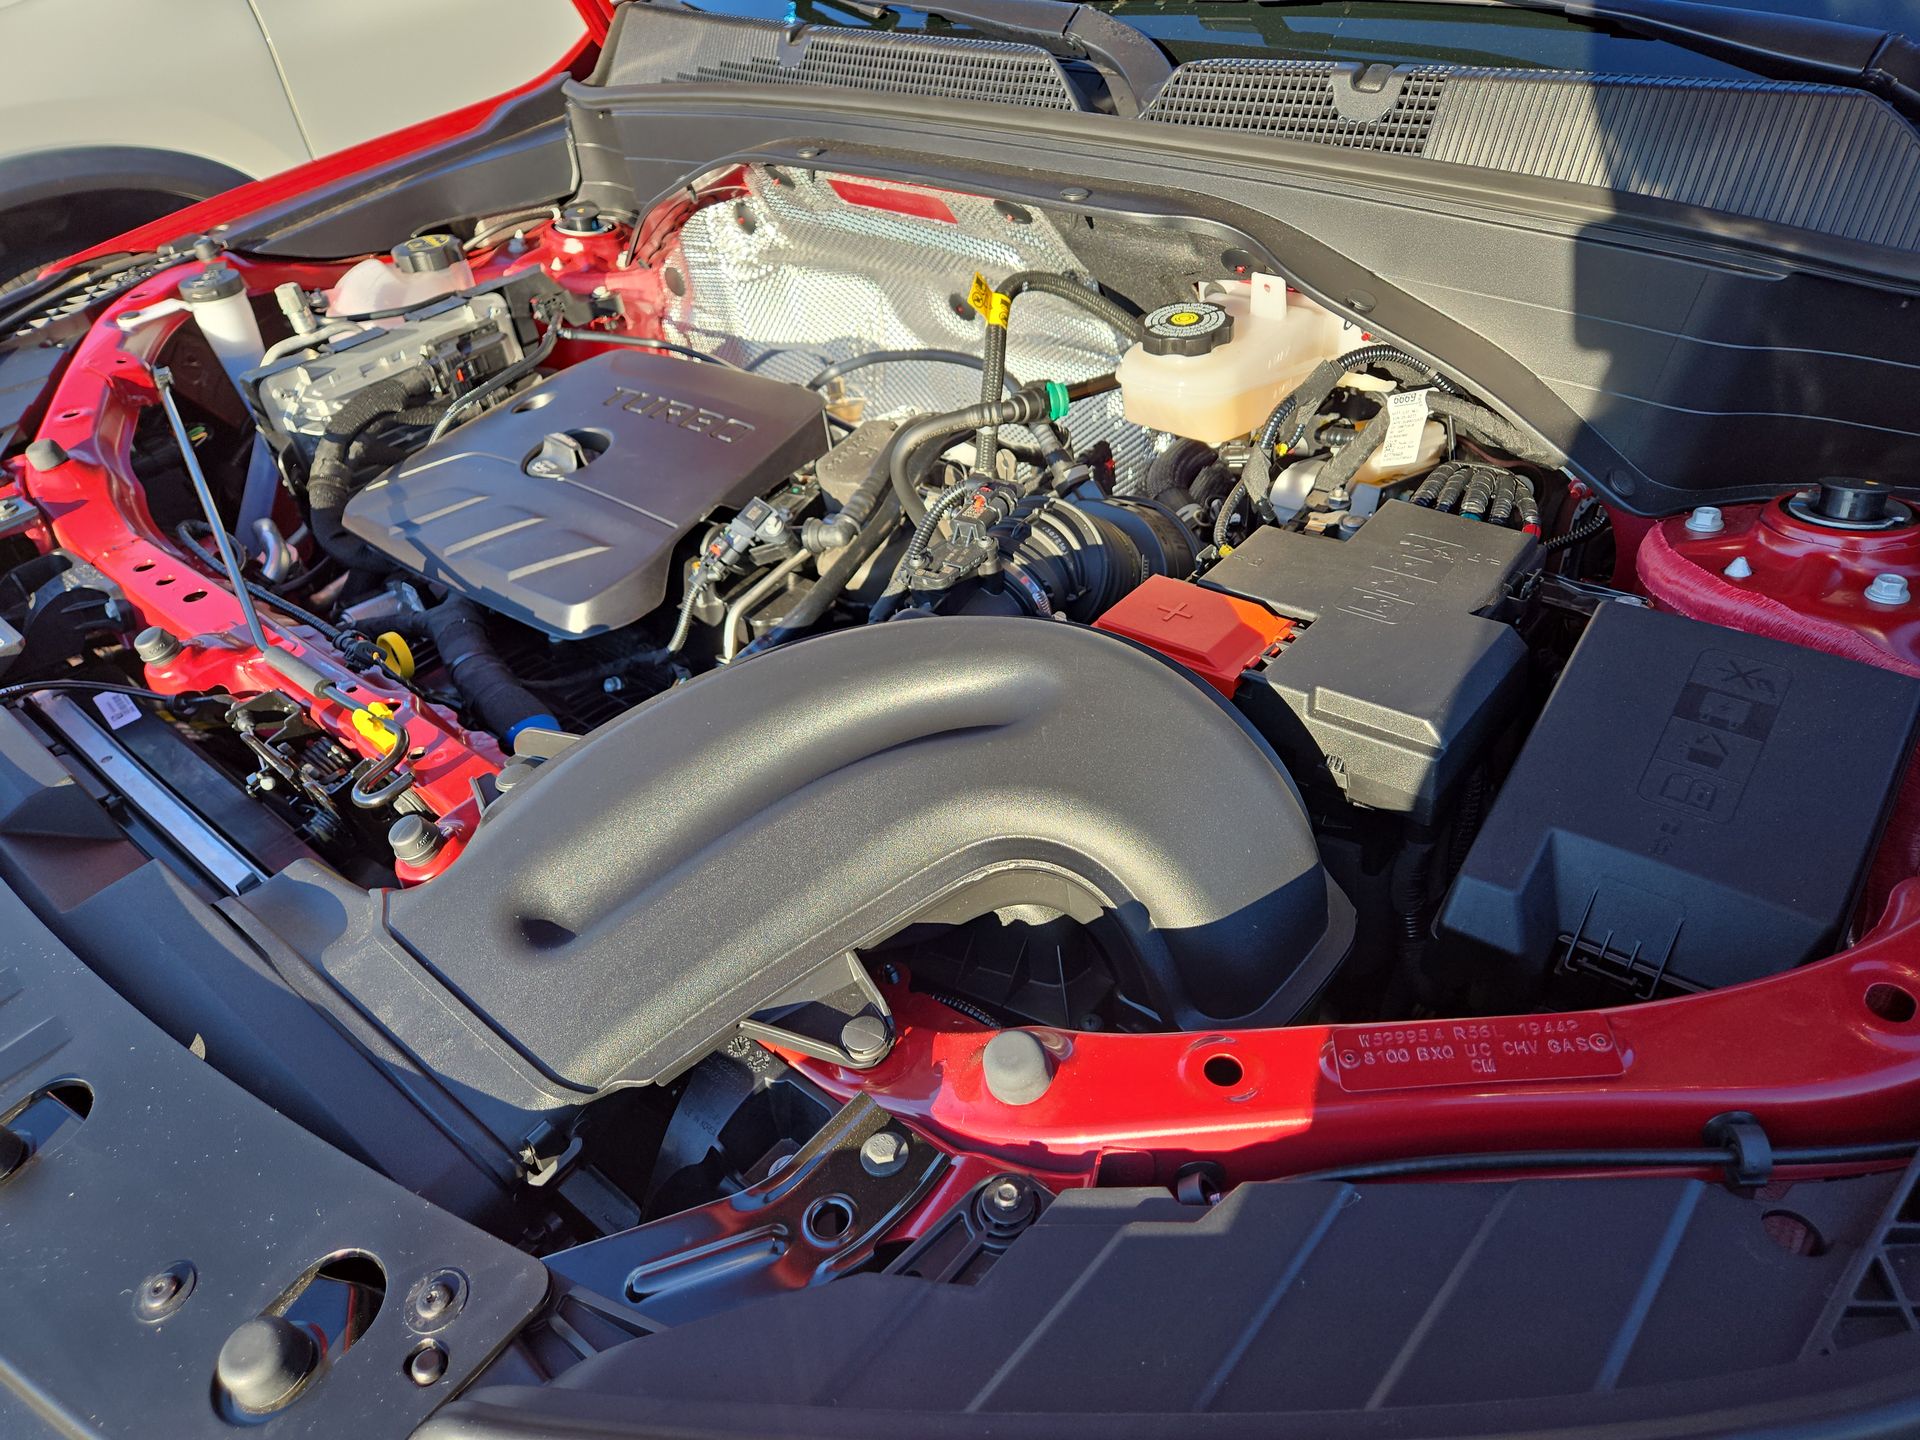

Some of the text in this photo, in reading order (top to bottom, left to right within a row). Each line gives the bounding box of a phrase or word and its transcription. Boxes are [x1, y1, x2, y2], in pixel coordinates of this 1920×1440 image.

[602, 386, 756, 443] TURBO
[1364, 1047, 1411, 1065] 8100
[1464, 1041, 1492, 1058] UC
[1502, 1039, 1538, 1056] CHV
[1547, 1036, 1590, 1054] GAS
[1471, 1058, 1497, 1073] CM
